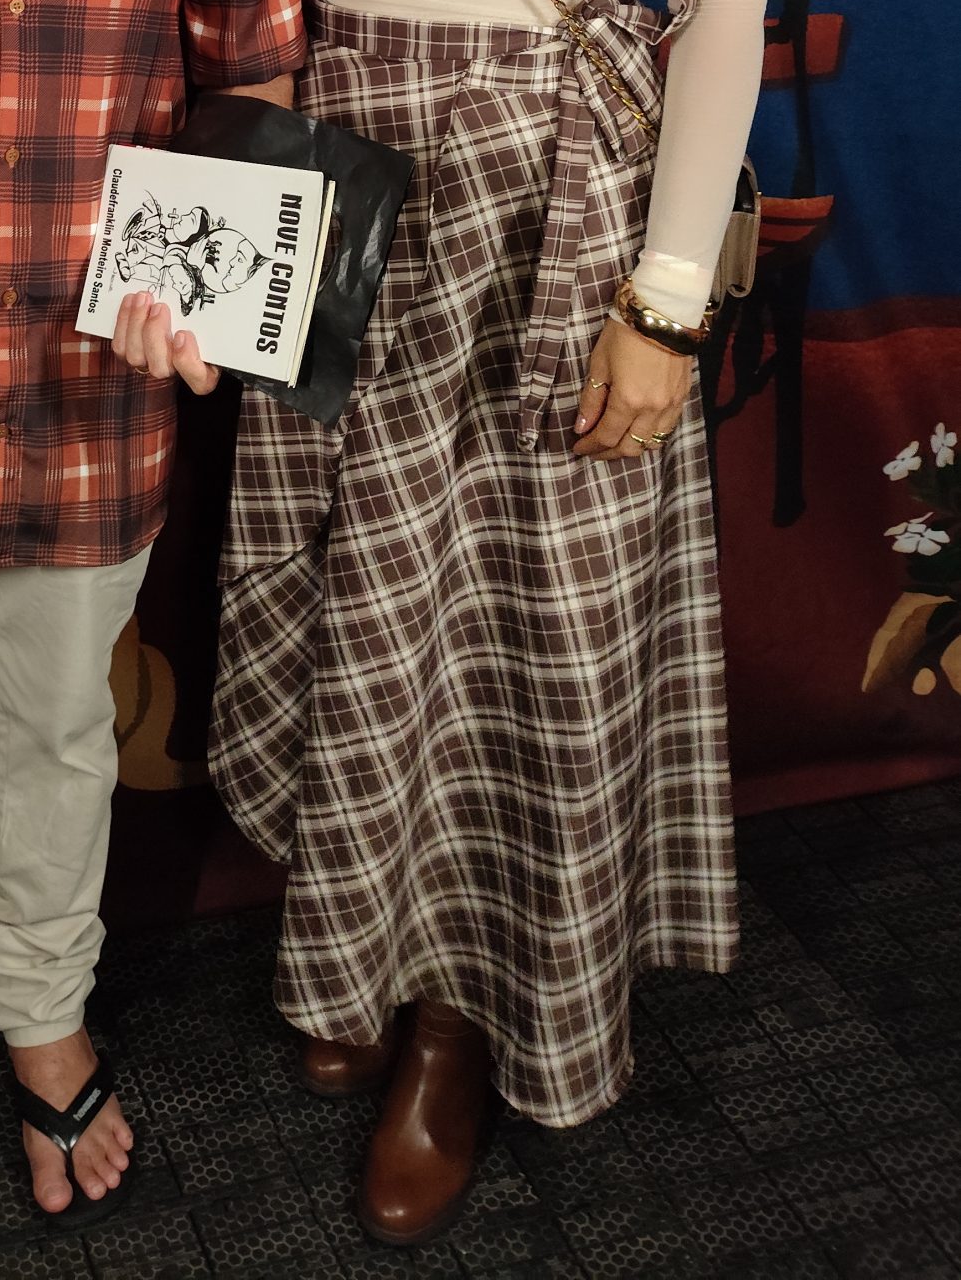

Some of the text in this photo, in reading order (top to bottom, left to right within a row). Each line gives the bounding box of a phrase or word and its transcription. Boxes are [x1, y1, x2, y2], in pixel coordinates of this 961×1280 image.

[87, 168, 123, 314] Claudefranklin Monteiro Santos
[256, 193, 303, 355] NOVE CONTOS
